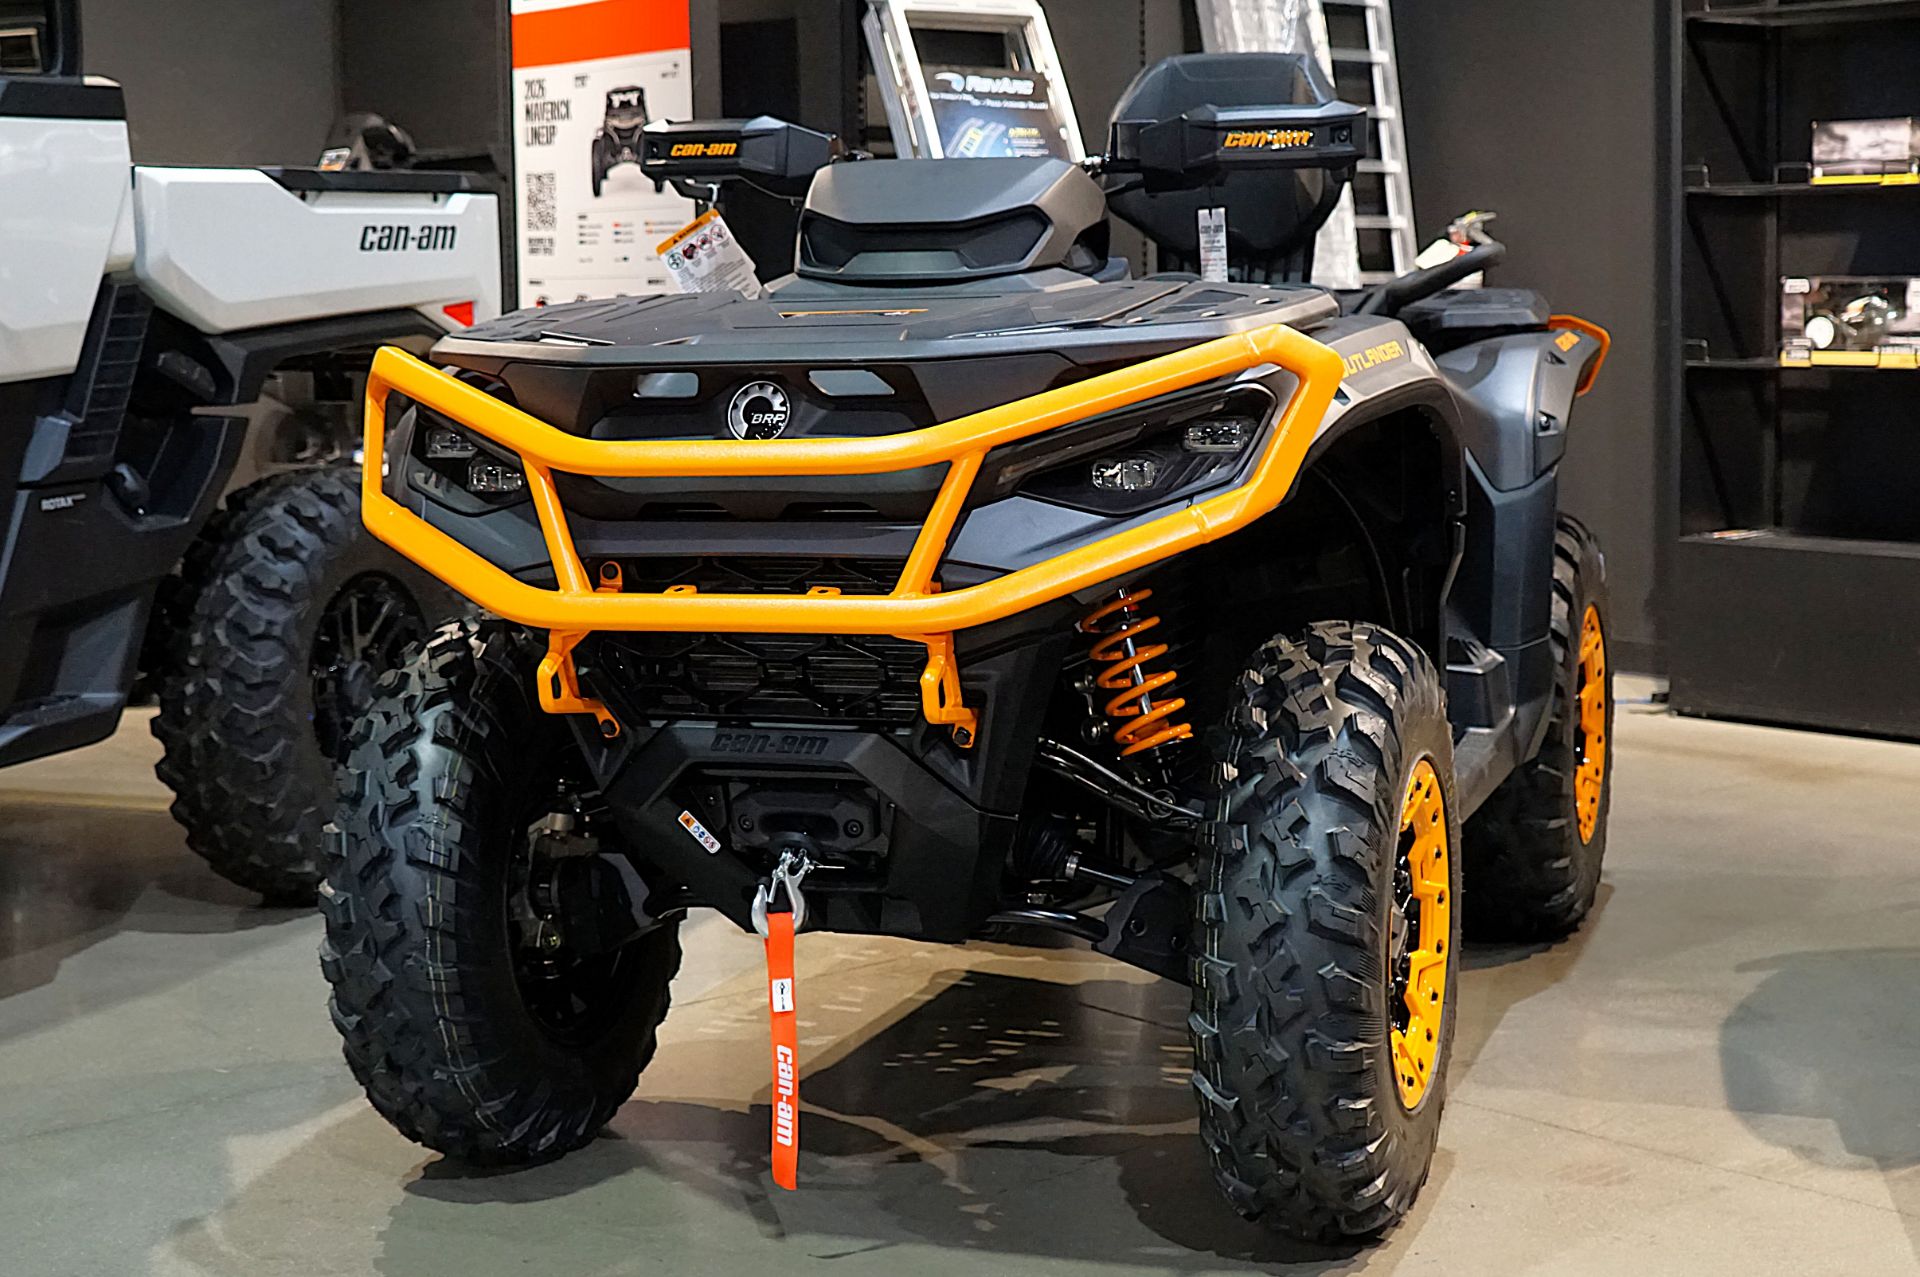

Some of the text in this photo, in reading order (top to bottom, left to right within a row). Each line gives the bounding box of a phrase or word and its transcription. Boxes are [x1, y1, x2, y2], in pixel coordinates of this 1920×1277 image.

[525, 100, 571, 121] MAVERICK
[525, 125, 556, 146] LINEUP
[670, 143, 738, 157] can-am
[359, 225, 457, 251] can-am
[751, 413, 785, 424] BRP
[711, 733, 829, 754] can-am
[776, 1044, 793, 1147] can-am
